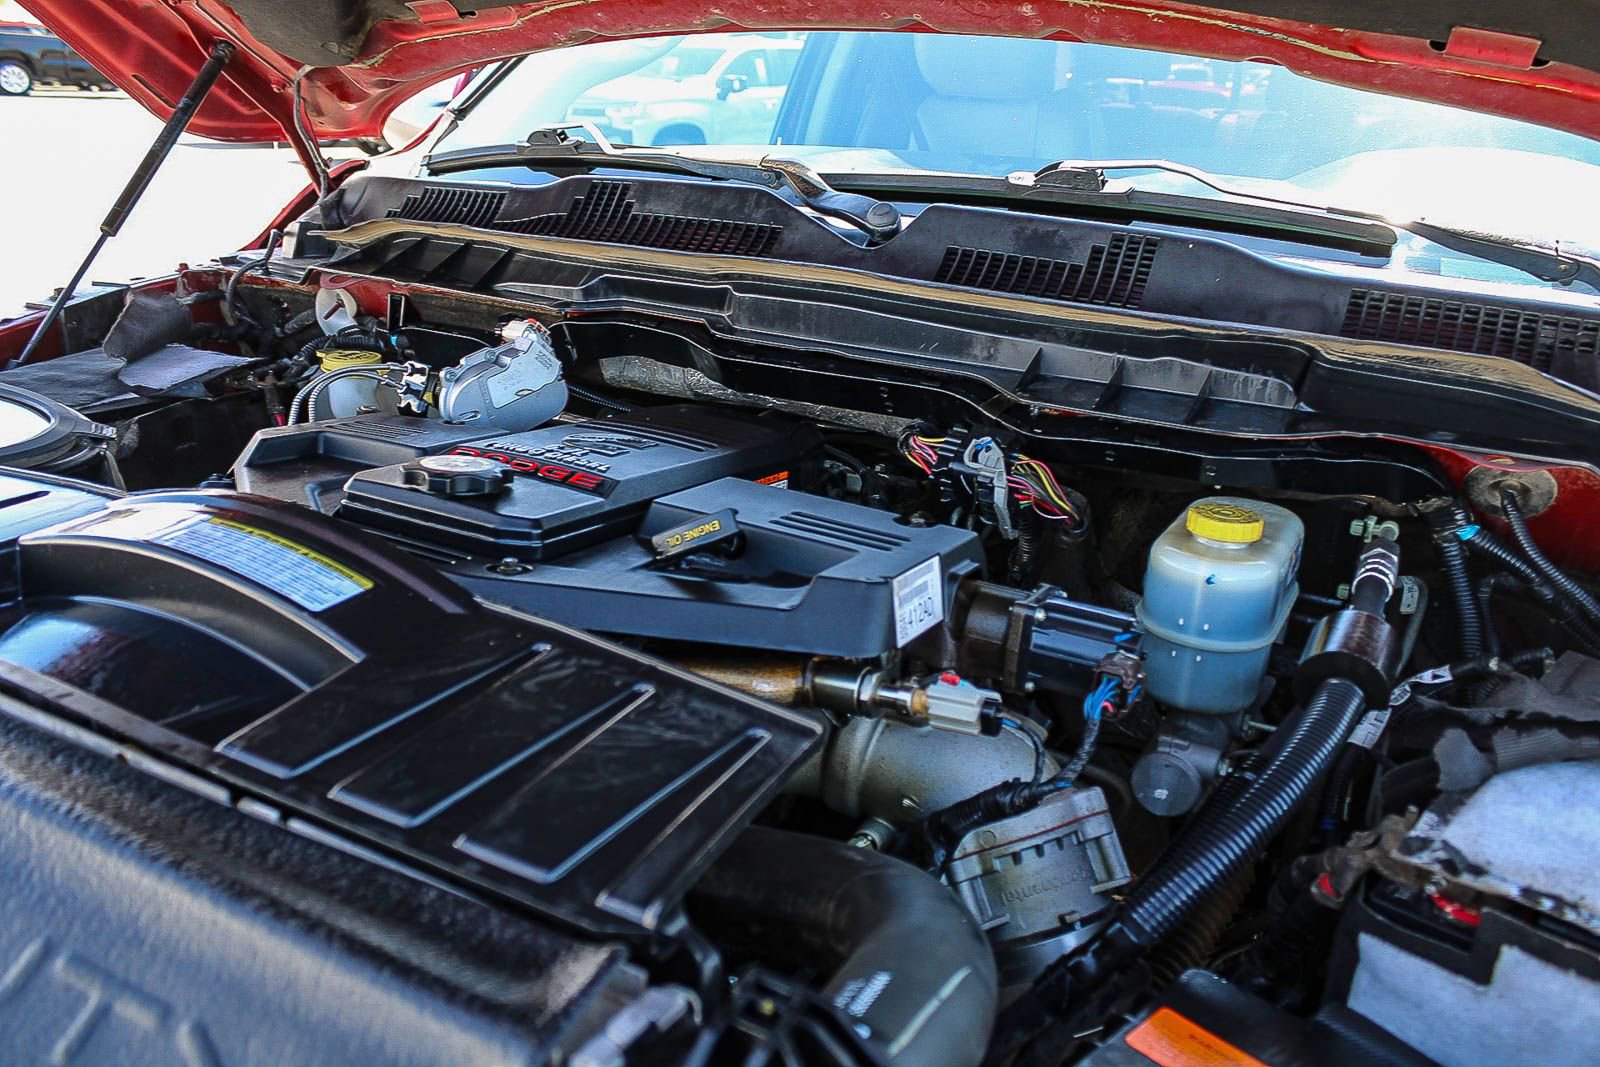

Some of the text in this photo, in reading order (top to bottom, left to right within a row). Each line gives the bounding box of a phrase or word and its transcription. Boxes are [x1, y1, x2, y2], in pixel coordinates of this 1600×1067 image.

[451, 447, 604, 489] DODGE
[544, 450, 611, 473] DIESEL
[665, 519, 721, 548] ENGINE OIL
